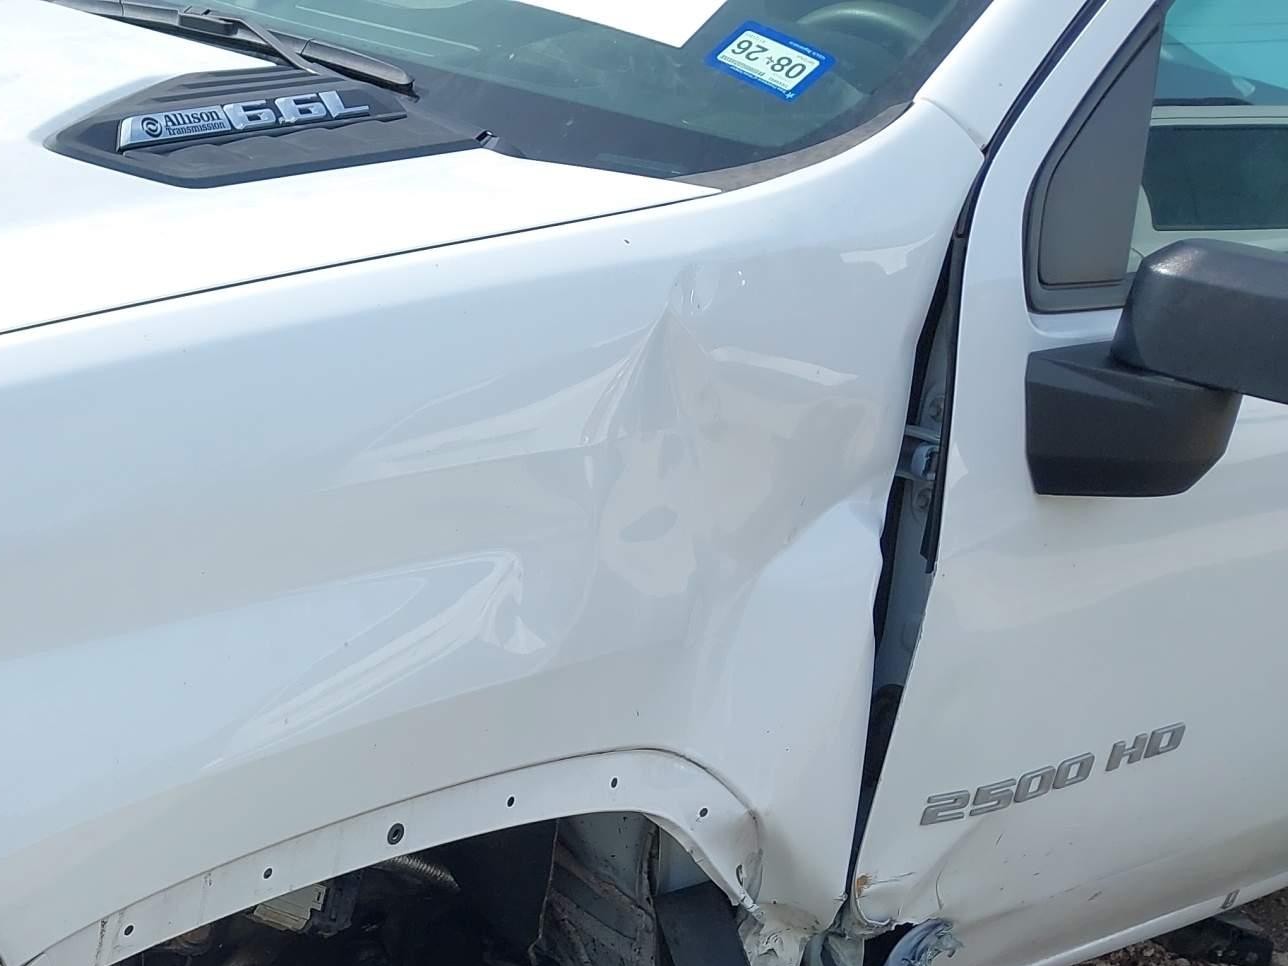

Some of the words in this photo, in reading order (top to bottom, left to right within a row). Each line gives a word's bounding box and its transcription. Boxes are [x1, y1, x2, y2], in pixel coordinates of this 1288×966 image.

[163, 110, 223, 128] Allison
[165, 121, 226, 136] Transmission
[919, 751, 1096, 826] 2500
[1104, 721, 1186, 772] HD
